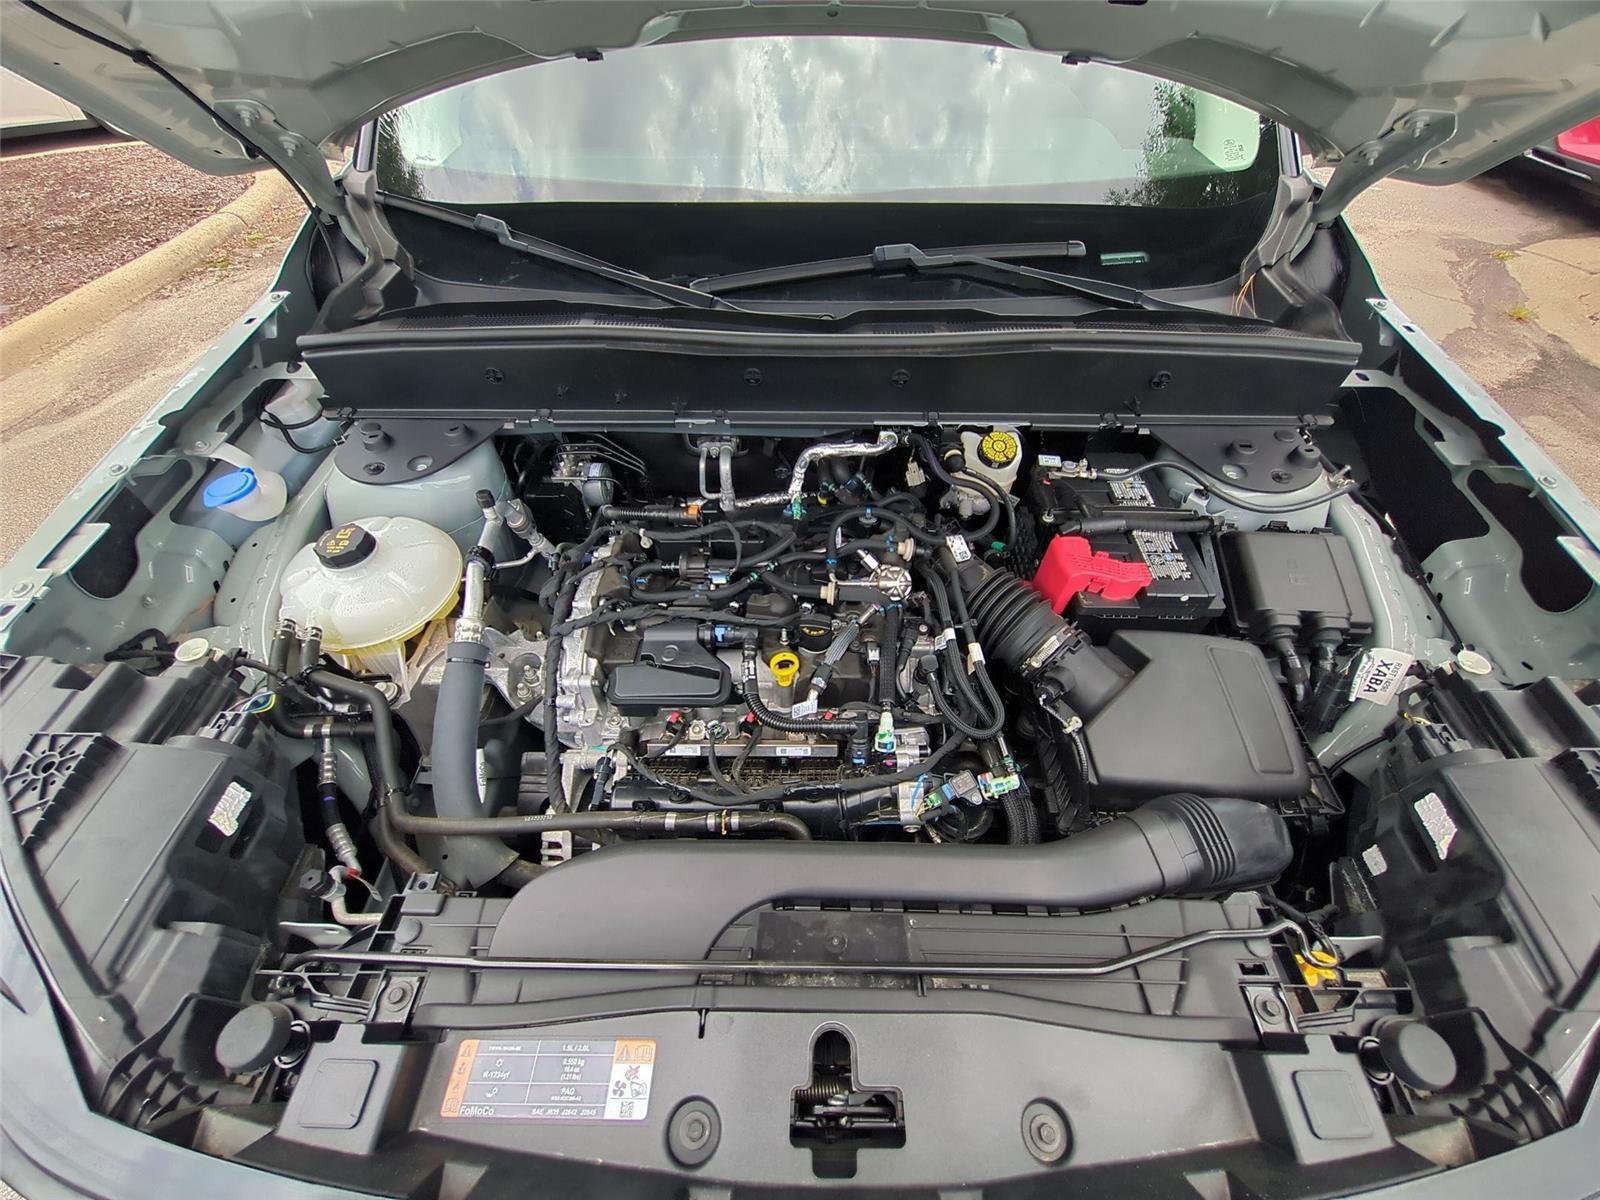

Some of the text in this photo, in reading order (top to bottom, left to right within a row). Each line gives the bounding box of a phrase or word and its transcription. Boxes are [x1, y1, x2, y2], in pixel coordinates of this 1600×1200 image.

[1363, 660, 1394, 693] XABA
[482, 1071, 511, 1080] R-1234yf
[460, 1105, 495, 1115] FoMoCo
